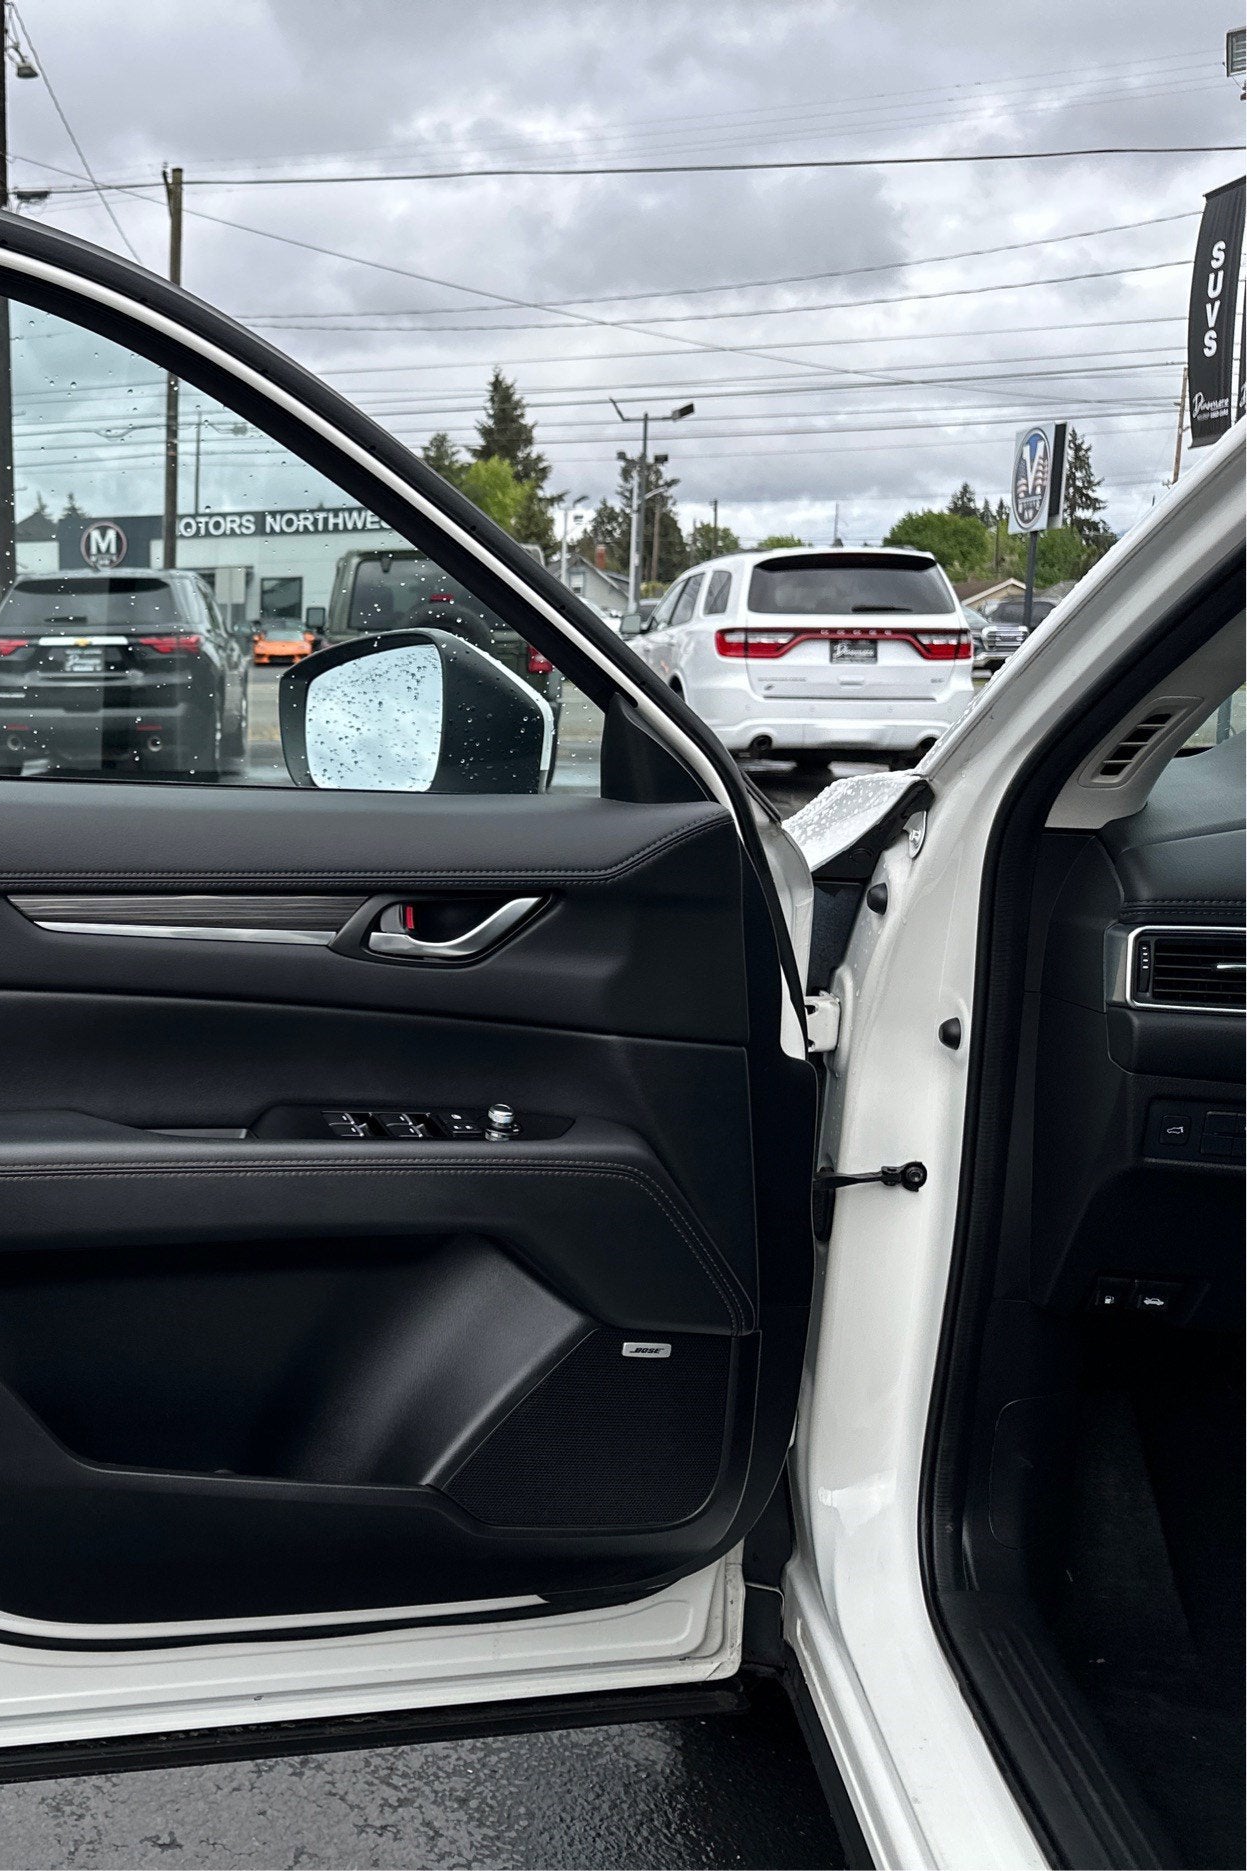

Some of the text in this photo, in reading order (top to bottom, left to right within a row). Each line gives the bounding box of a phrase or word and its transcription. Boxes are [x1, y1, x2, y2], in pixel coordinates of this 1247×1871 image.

[1203, 240, 1226, 358] SUVS
[176, 514, 256, 537] OTORS
[90, 529, 117, 555] M
